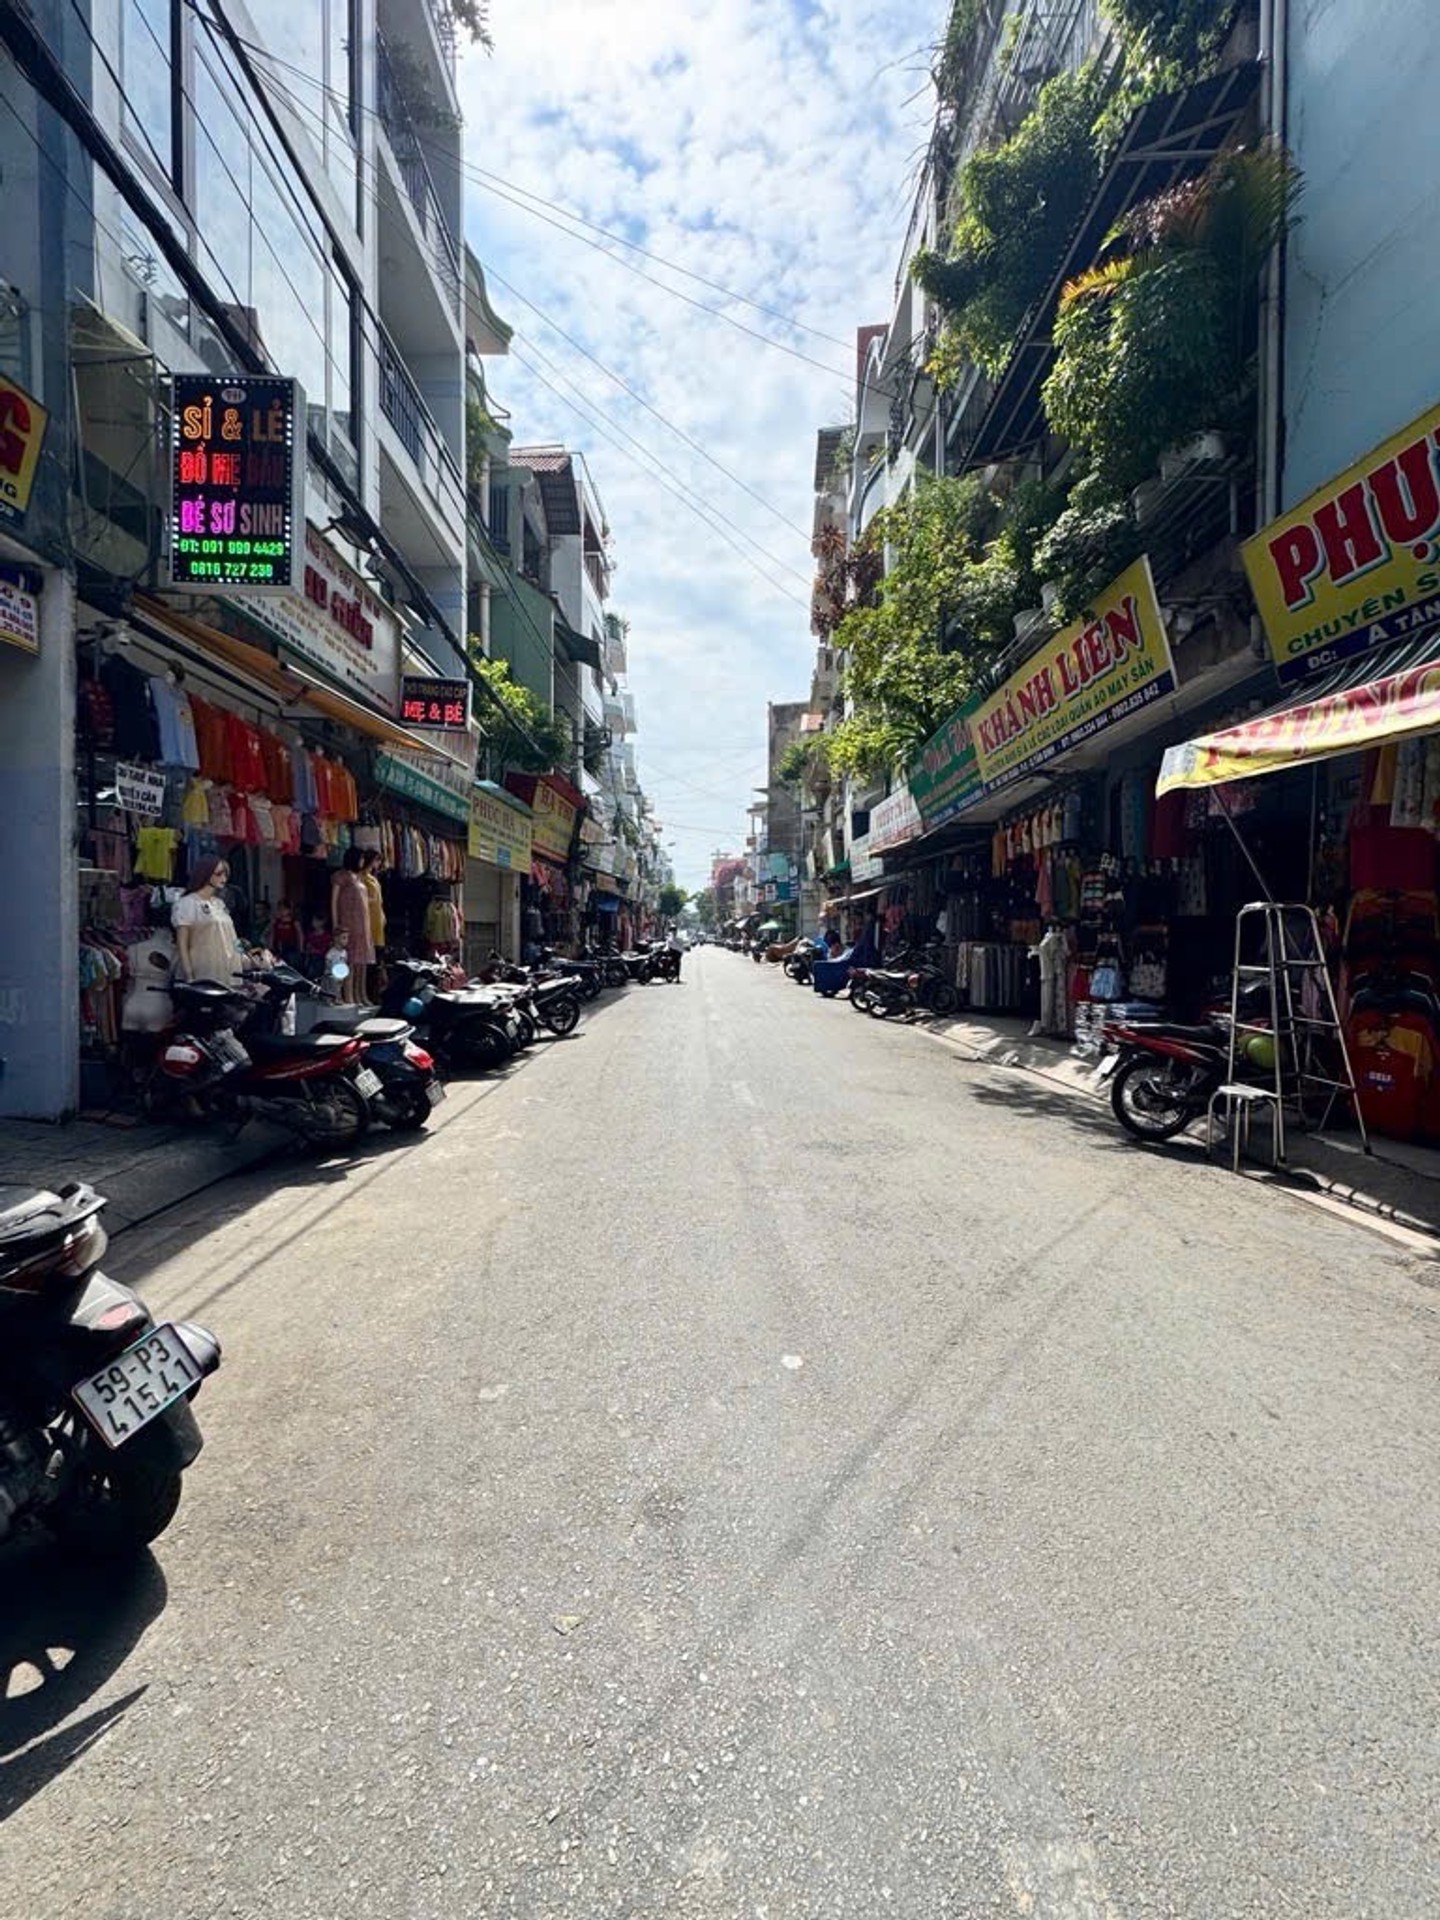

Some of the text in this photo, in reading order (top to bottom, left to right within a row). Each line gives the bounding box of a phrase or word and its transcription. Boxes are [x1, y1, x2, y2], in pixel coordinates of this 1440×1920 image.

[184, 396, 212, 439] SỈ
[221, 408, 243, 440] &
[210, 500, 235, 535] SƠ
[240, 503, 283, 535] SINH
[1269, 428, 1440, 609] PHỤ
[1287, 587, 1406, 654] CHUYÊN
[1307, 649, 1338, 670] ĐC:
[1368, 624, 1391, 648] A
[404, 700, 464, 722] MẸ & BÉ
[977, 667, 1058, 757] KHÁNH
[1106, 674, 1131, 699] MAY
[91, 1337, 170, 1404] 59-P3
[106, 1357, 193, 1435] 415.41
